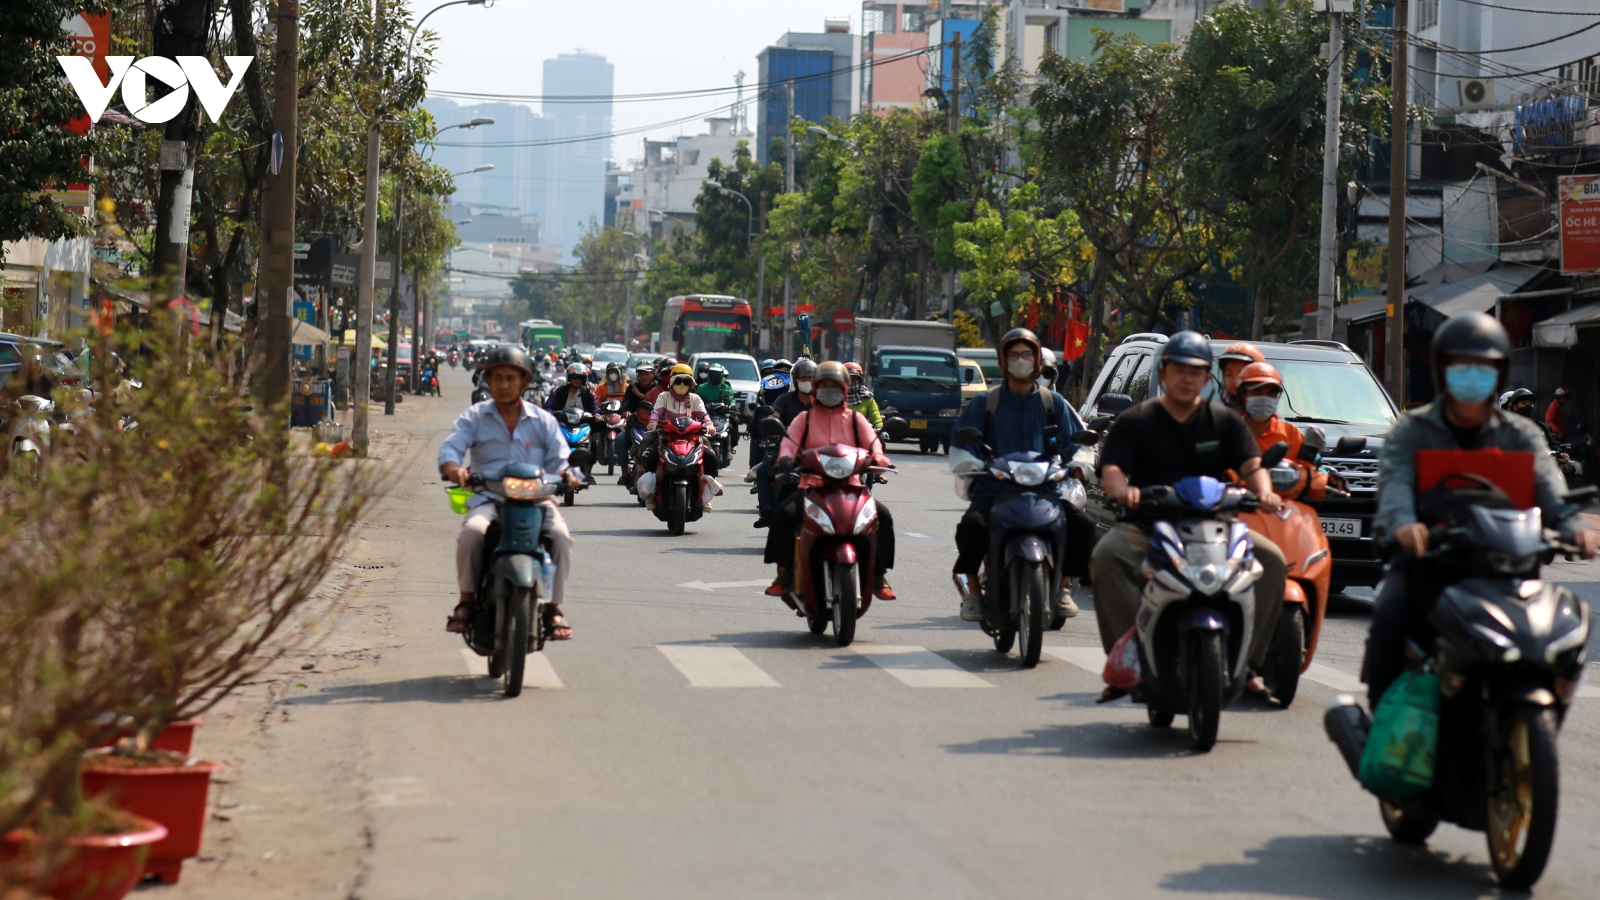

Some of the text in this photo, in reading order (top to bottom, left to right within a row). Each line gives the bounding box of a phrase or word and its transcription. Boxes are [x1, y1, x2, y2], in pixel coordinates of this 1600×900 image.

[1584, 184, 1600, 194] BIA
[1566, 215, 1581, 227] ỐC
[297, 307, 308, 321] XE
[295, 344, 305, 356] XE
